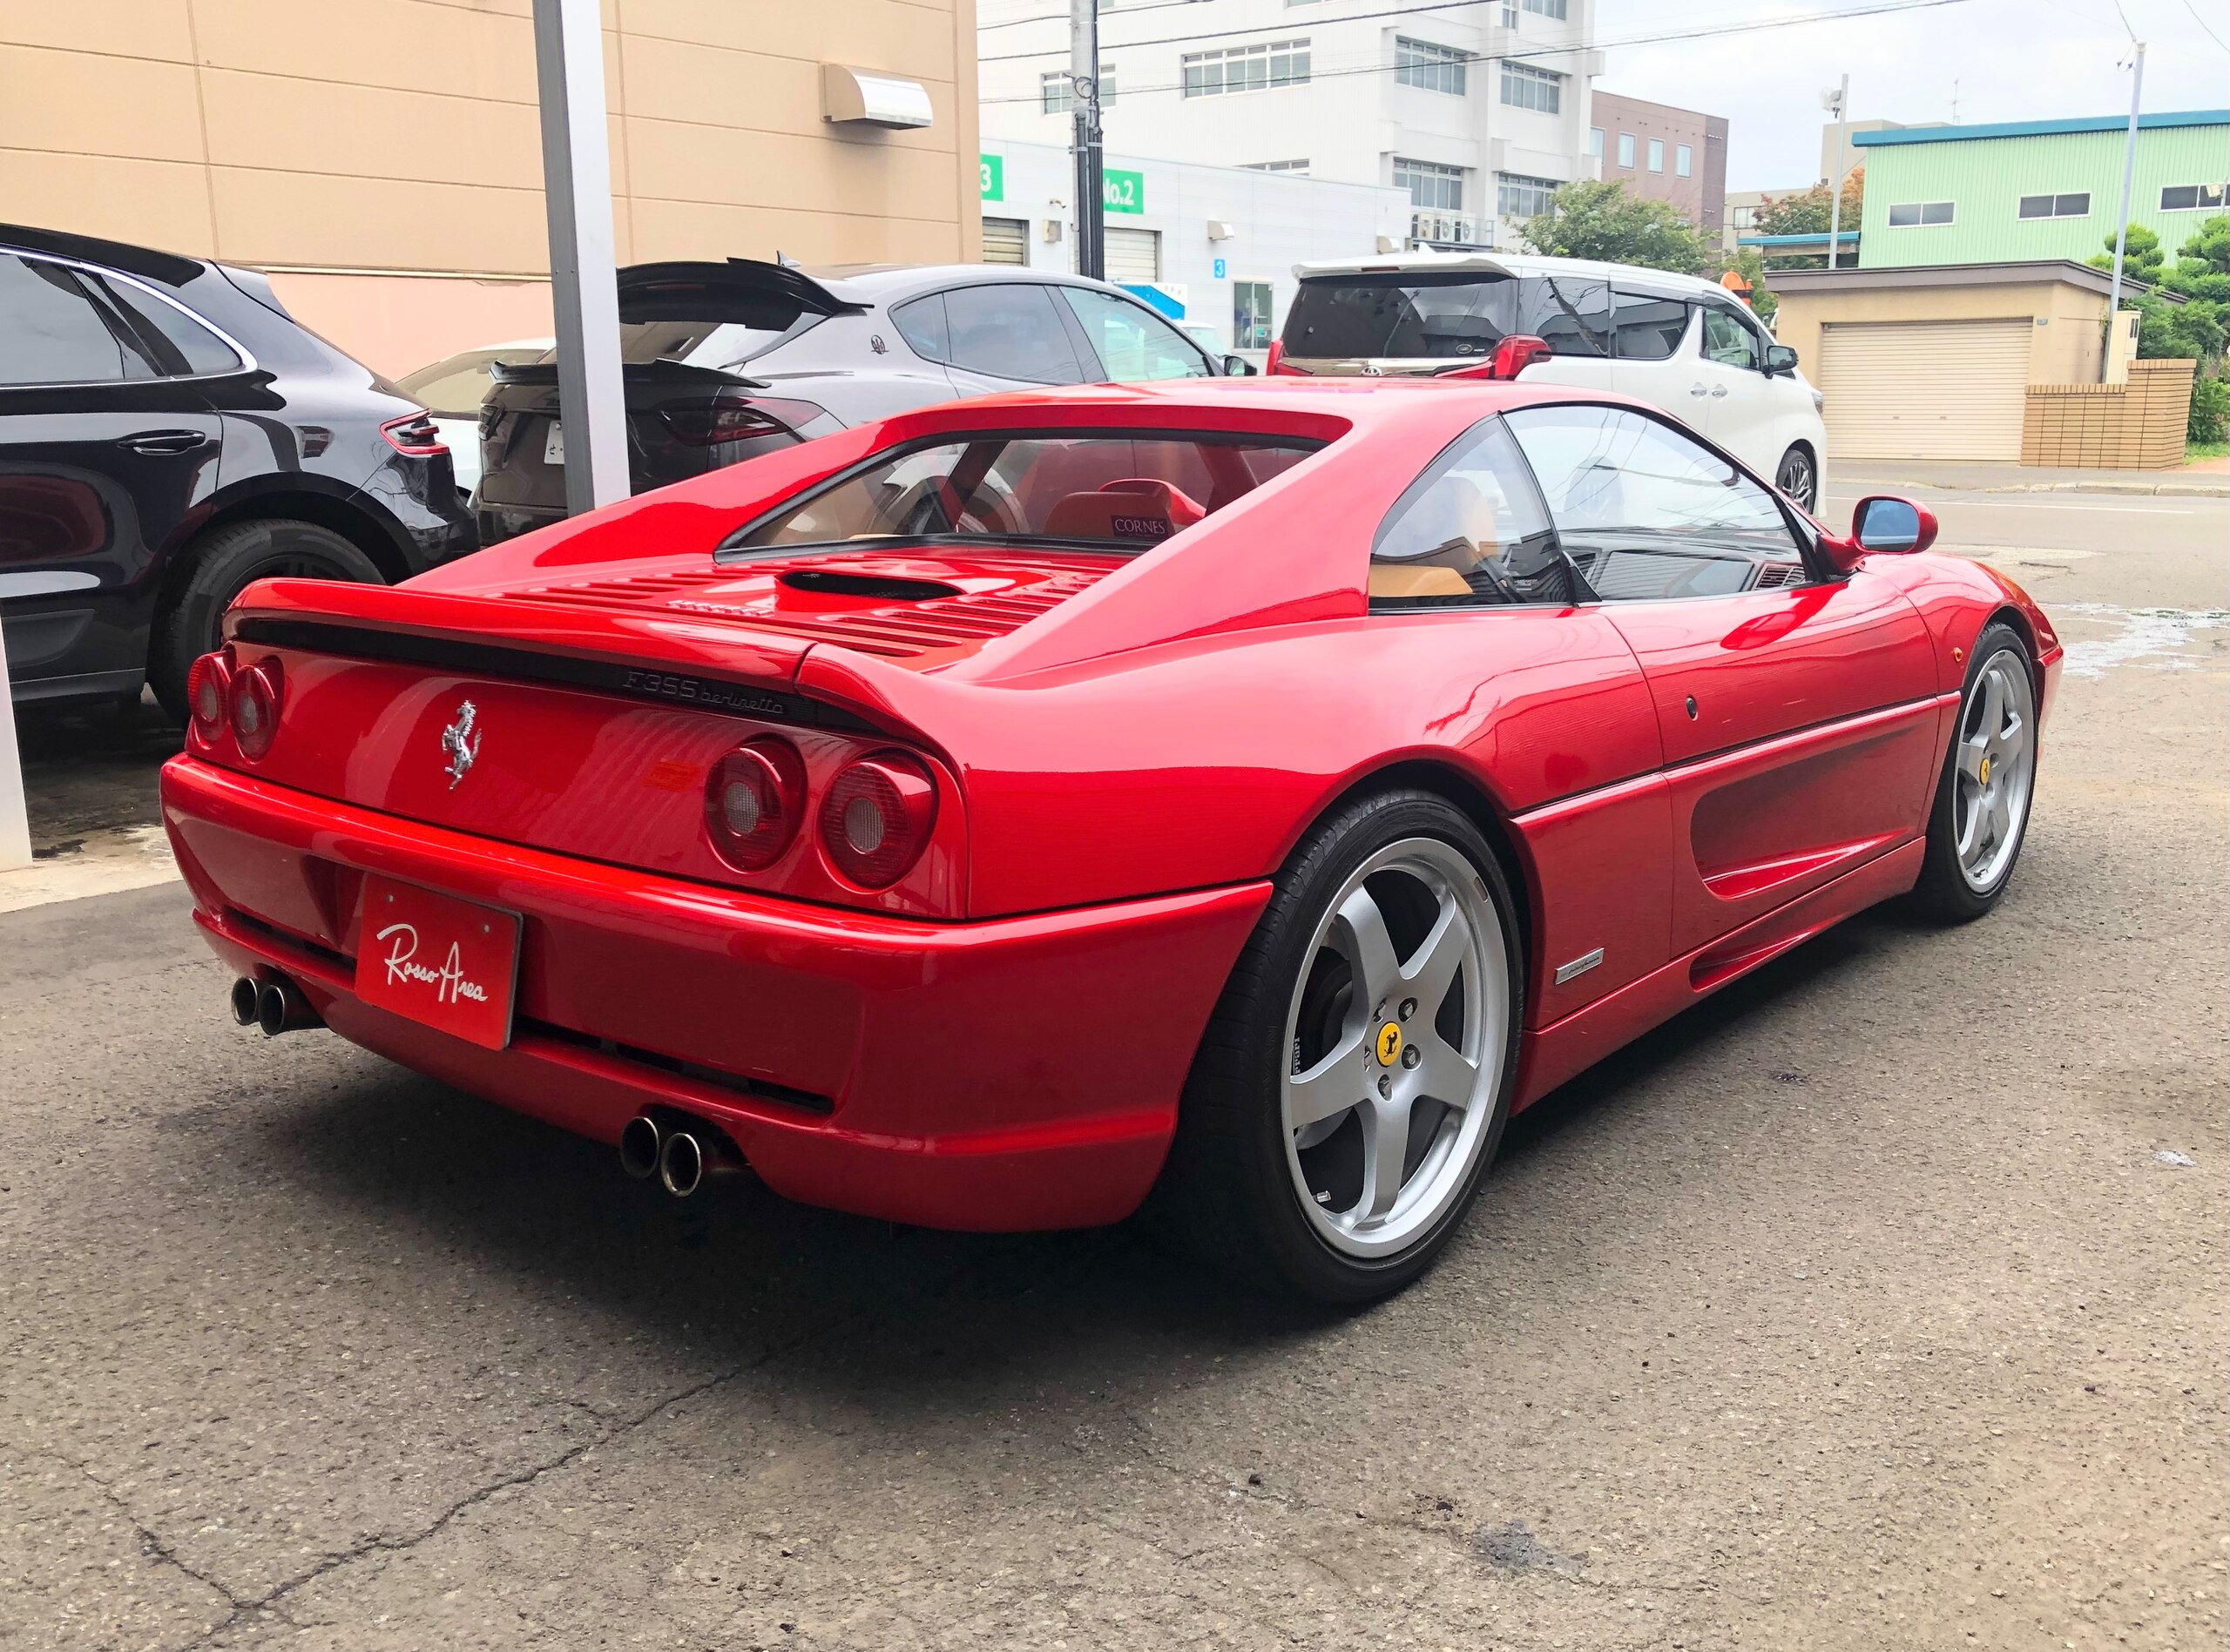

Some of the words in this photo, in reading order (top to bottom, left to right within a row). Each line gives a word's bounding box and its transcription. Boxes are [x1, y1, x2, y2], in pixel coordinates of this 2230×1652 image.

[1103, 177, 1135, 206] No.2
[1215, 260, 1224, 277] 3
[1115, 518, 1166, 535] CORNES
[622, 671, 699, 698] F355
[700, 686, 784, 715] berlinetta
[376, 923, 439, 986] Rosso
[438, 941, 489, 1004] Area
